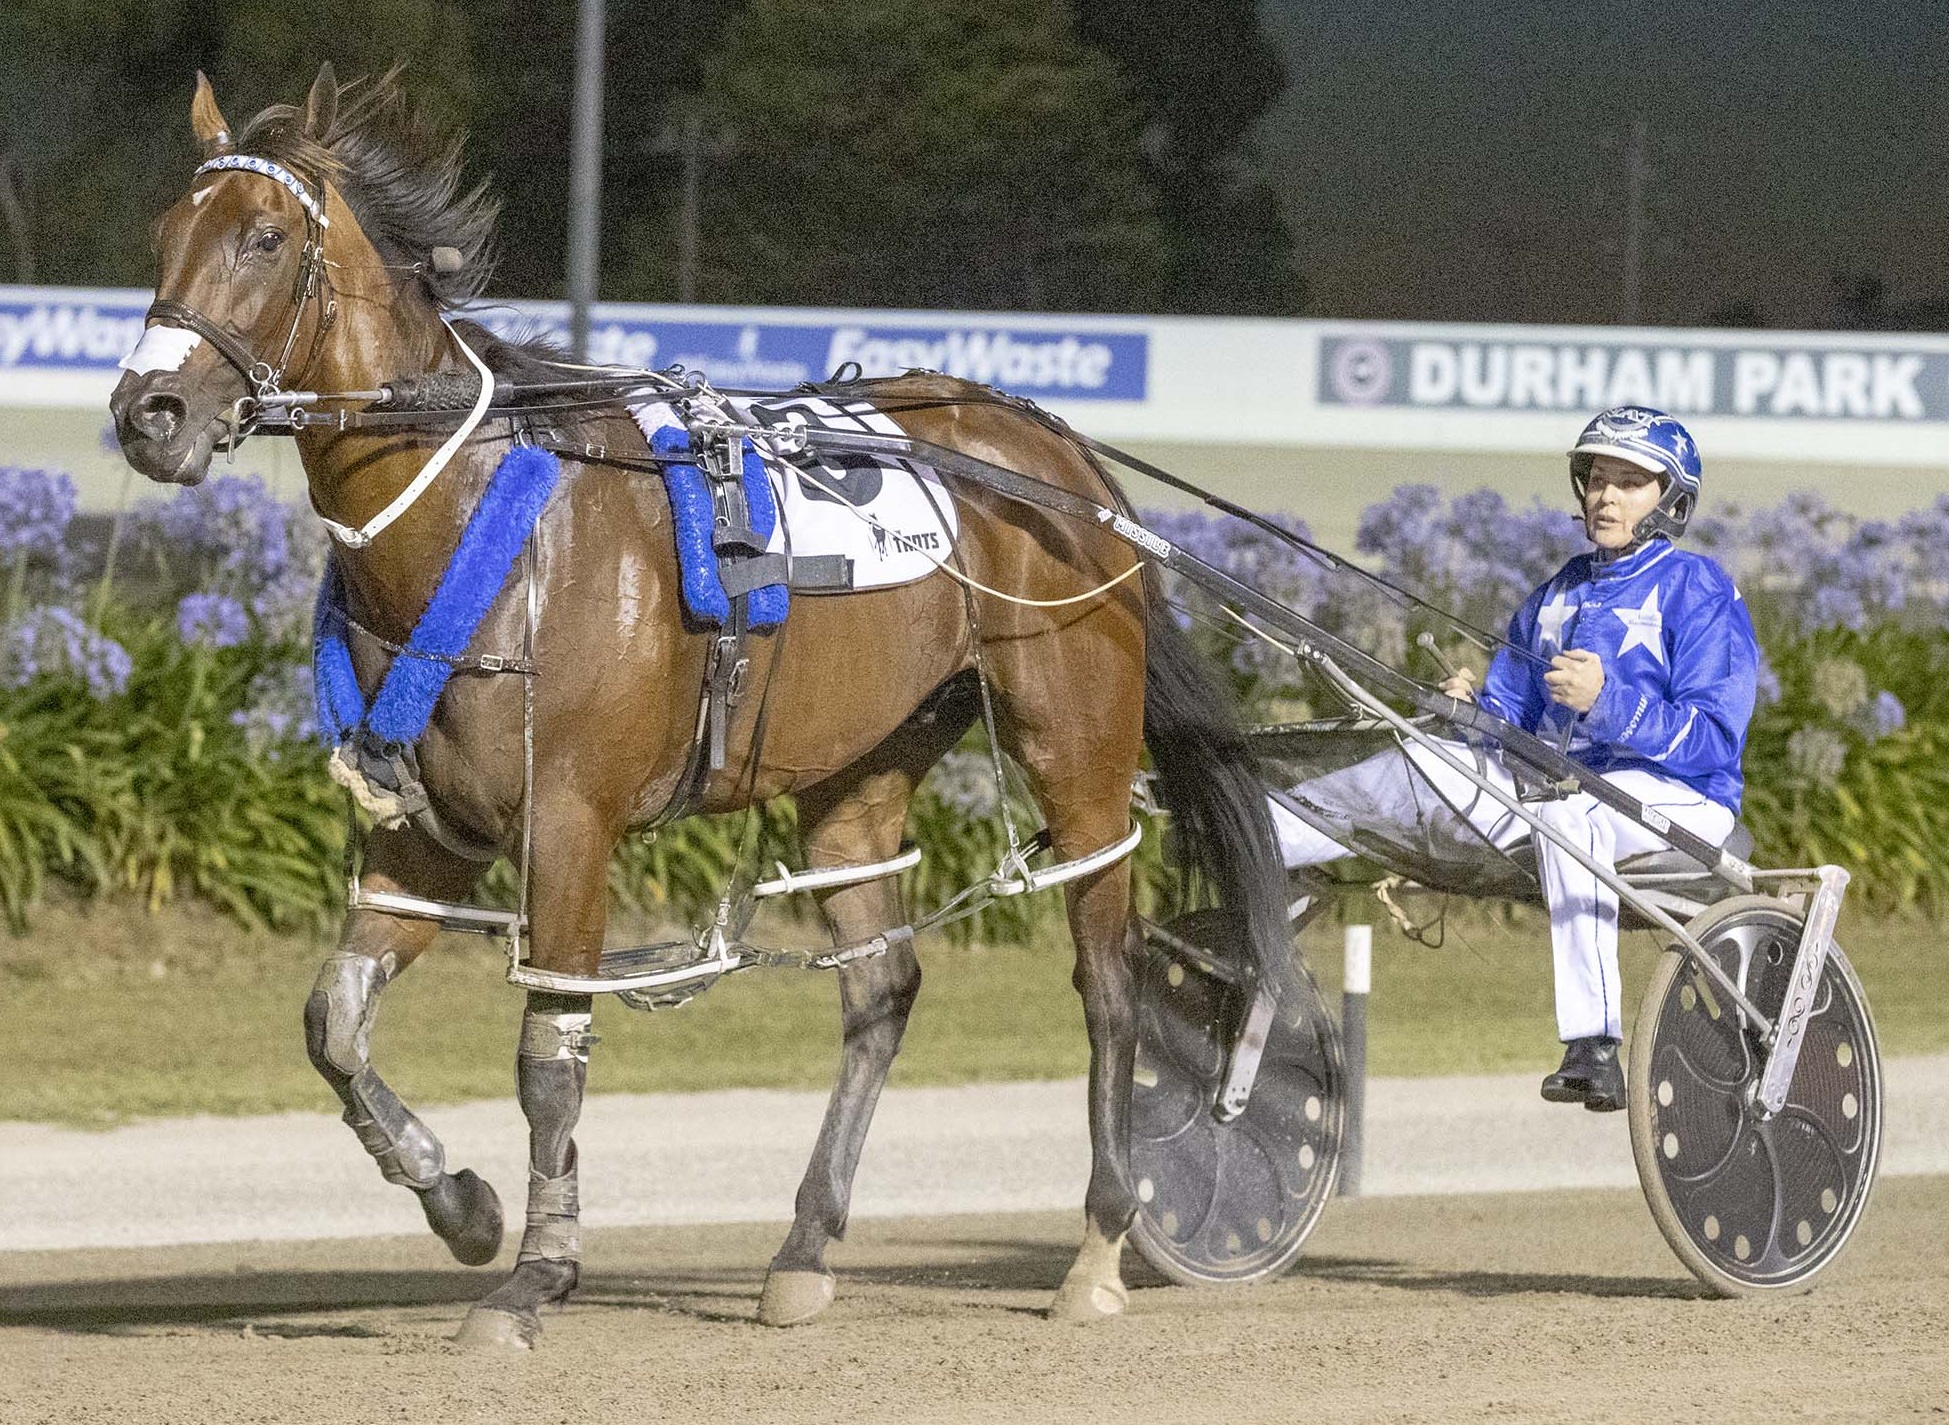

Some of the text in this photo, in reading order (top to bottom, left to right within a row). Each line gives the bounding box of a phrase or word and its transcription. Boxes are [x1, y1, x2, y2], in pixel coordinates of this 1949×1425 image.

[826, 327, 1113, 388] EasyWaste
[1410, 342, 1925, 419] DURHAM PARK
[893, 532, 939, 554] TROTS
[1113, 513, 1171, 558] MISSILE
